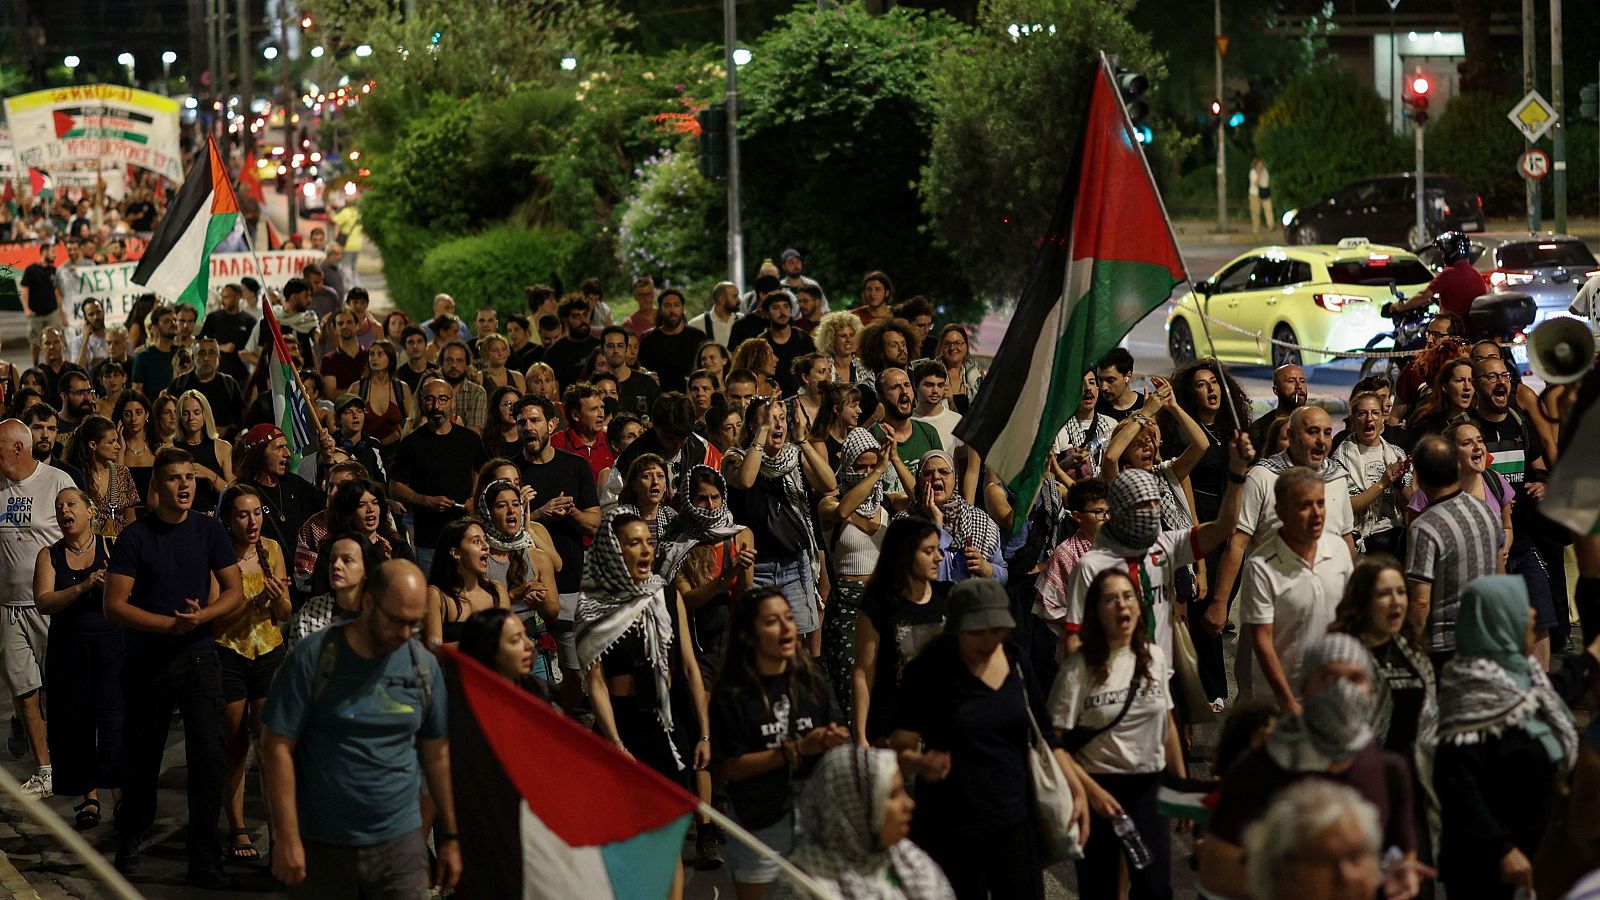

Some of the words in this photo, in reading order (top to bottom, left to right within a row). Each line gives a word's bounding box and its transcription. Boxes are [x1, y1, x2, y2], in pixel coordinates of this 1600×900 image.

[79, 264, 139, 294] ΛΕΥΤ
[1500, 472, 1525, 483] STINE
[7, 497, 33, 505] OPEN
[6, 512, 31, 524] RUN
